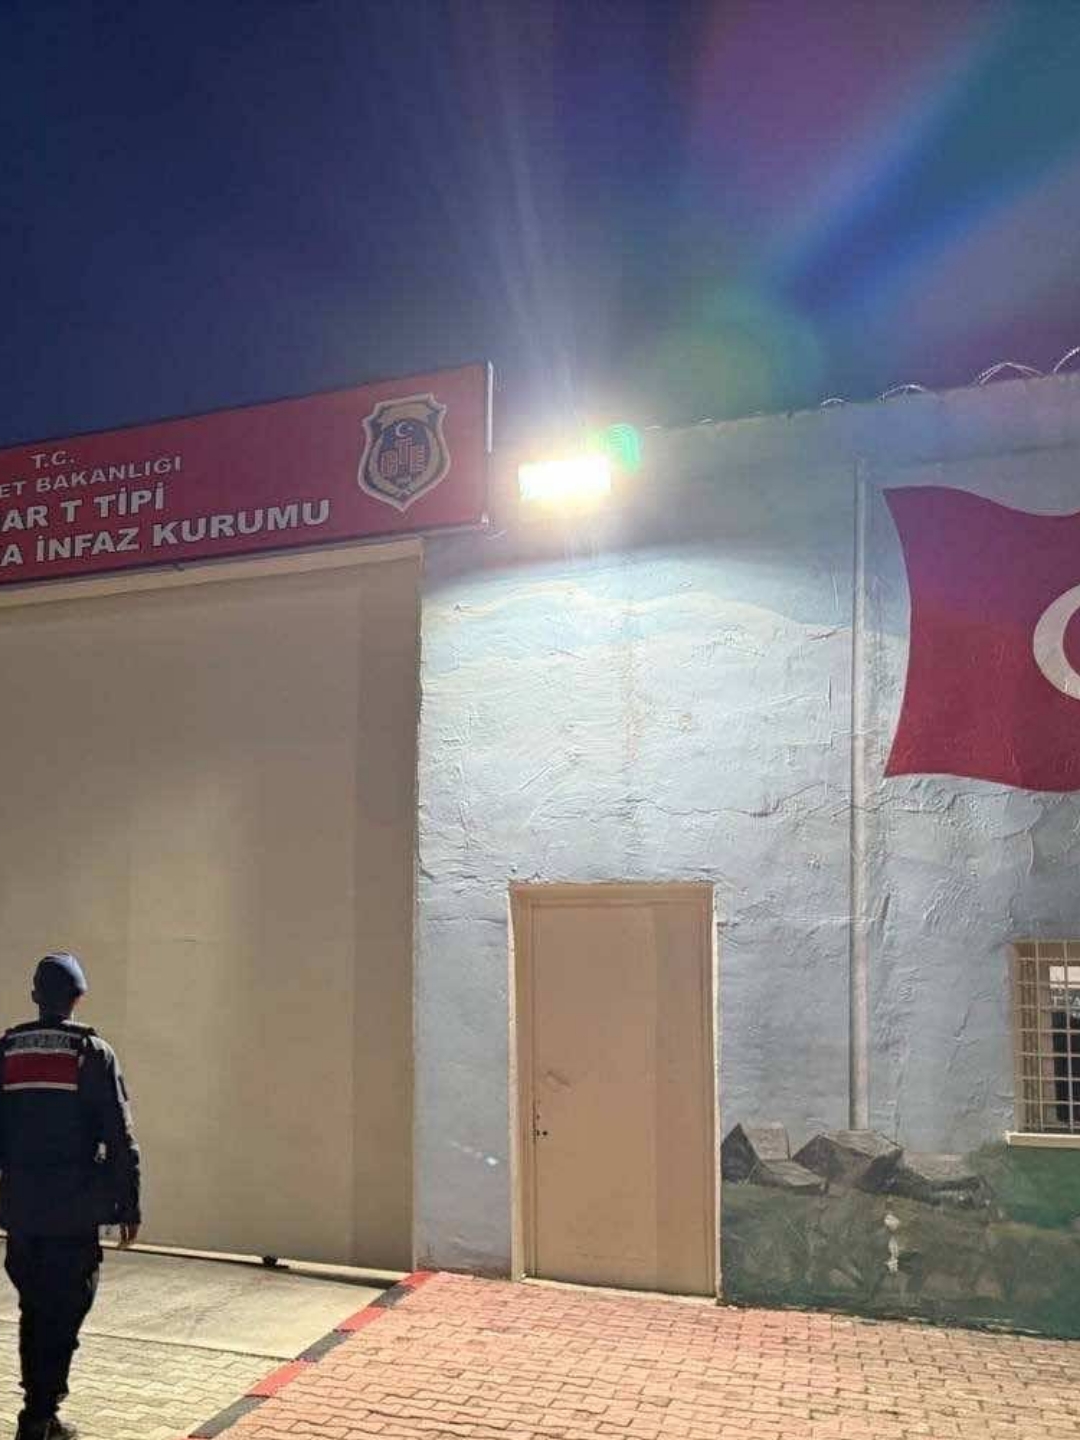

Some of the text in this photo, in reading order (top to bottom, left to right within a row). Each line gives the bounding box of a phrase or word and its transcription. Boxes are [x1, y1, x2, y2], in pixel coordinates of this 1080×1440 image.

[32, 450, 74, 469] T.C.
[60, 500, 82, 523] T
[94, 482, 165, 518] TİPİ
[36, 527, 139, 563] İNFAZ
[152, 499, 330, 547] KURUMU
